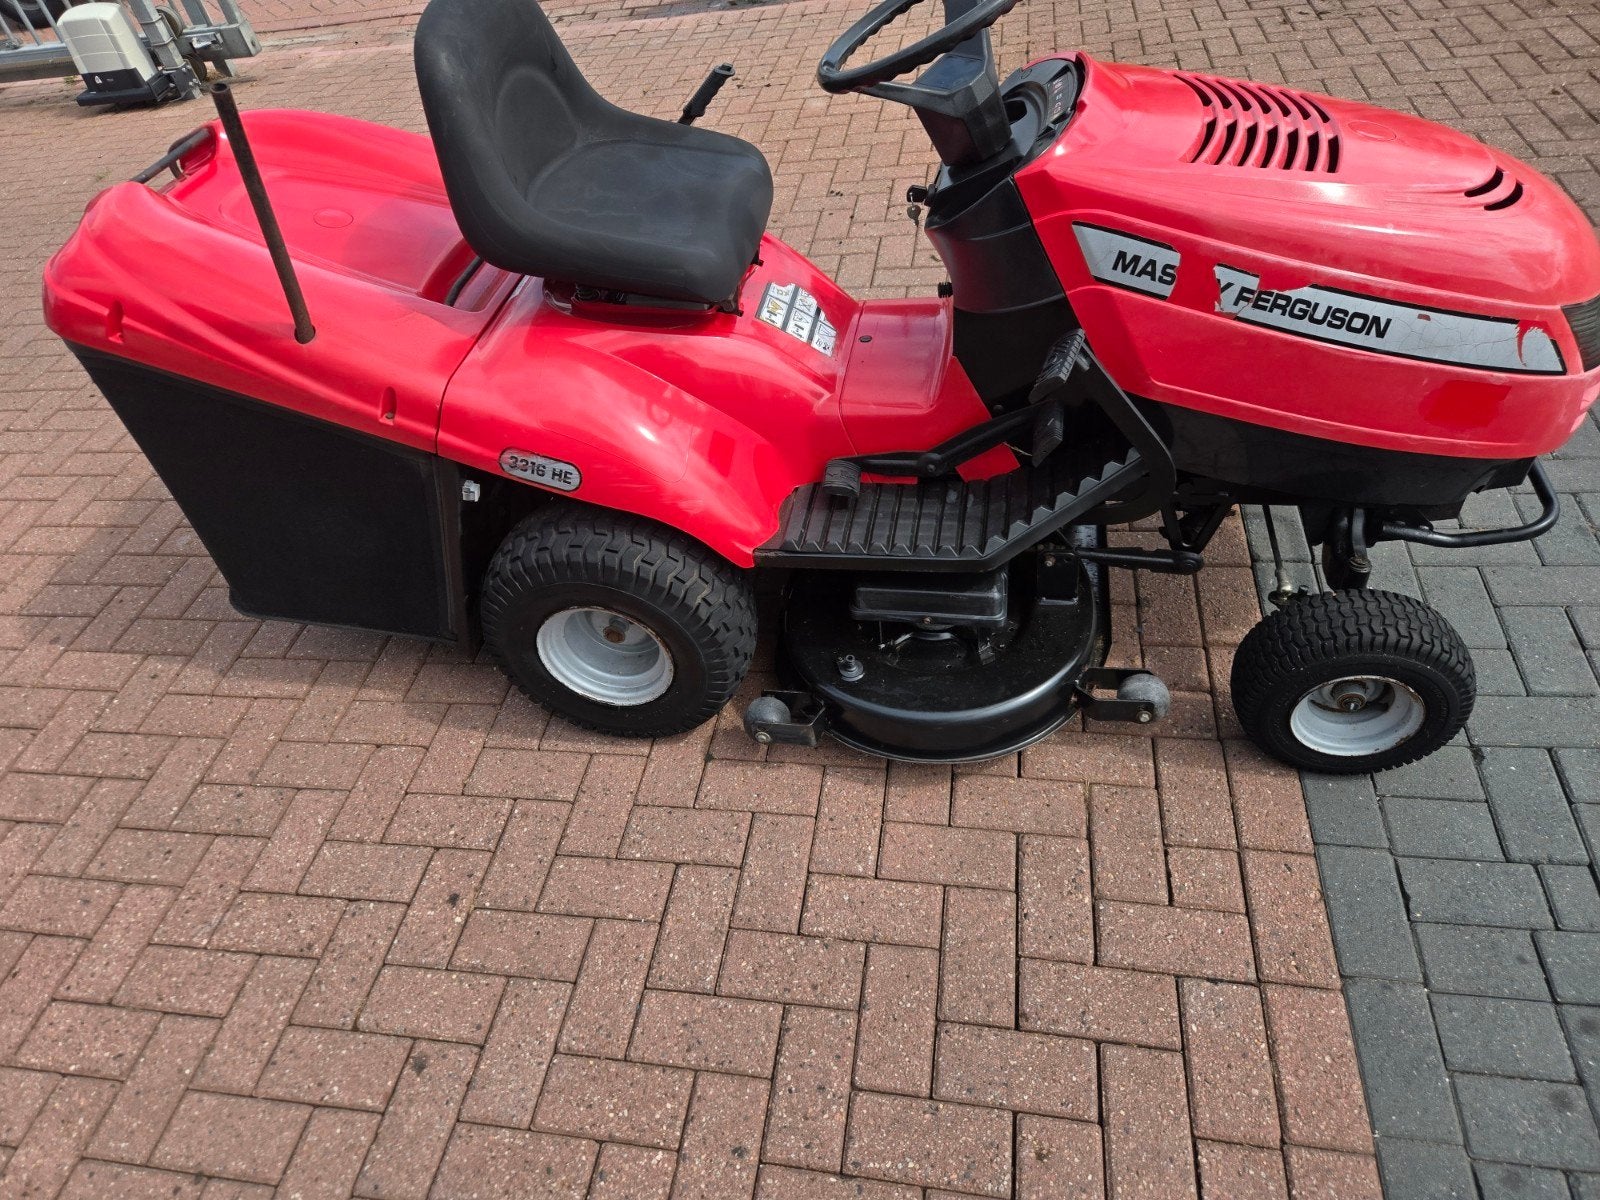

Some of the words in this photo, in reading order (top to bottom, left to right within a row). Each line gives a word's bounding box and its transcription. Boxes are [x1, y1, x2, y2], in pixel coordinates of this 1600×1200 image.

[1233, 286, 1393, 339] FERGUSON
[509, 455, 546, 477] 3216
[551, 467, 573, 485] HE
